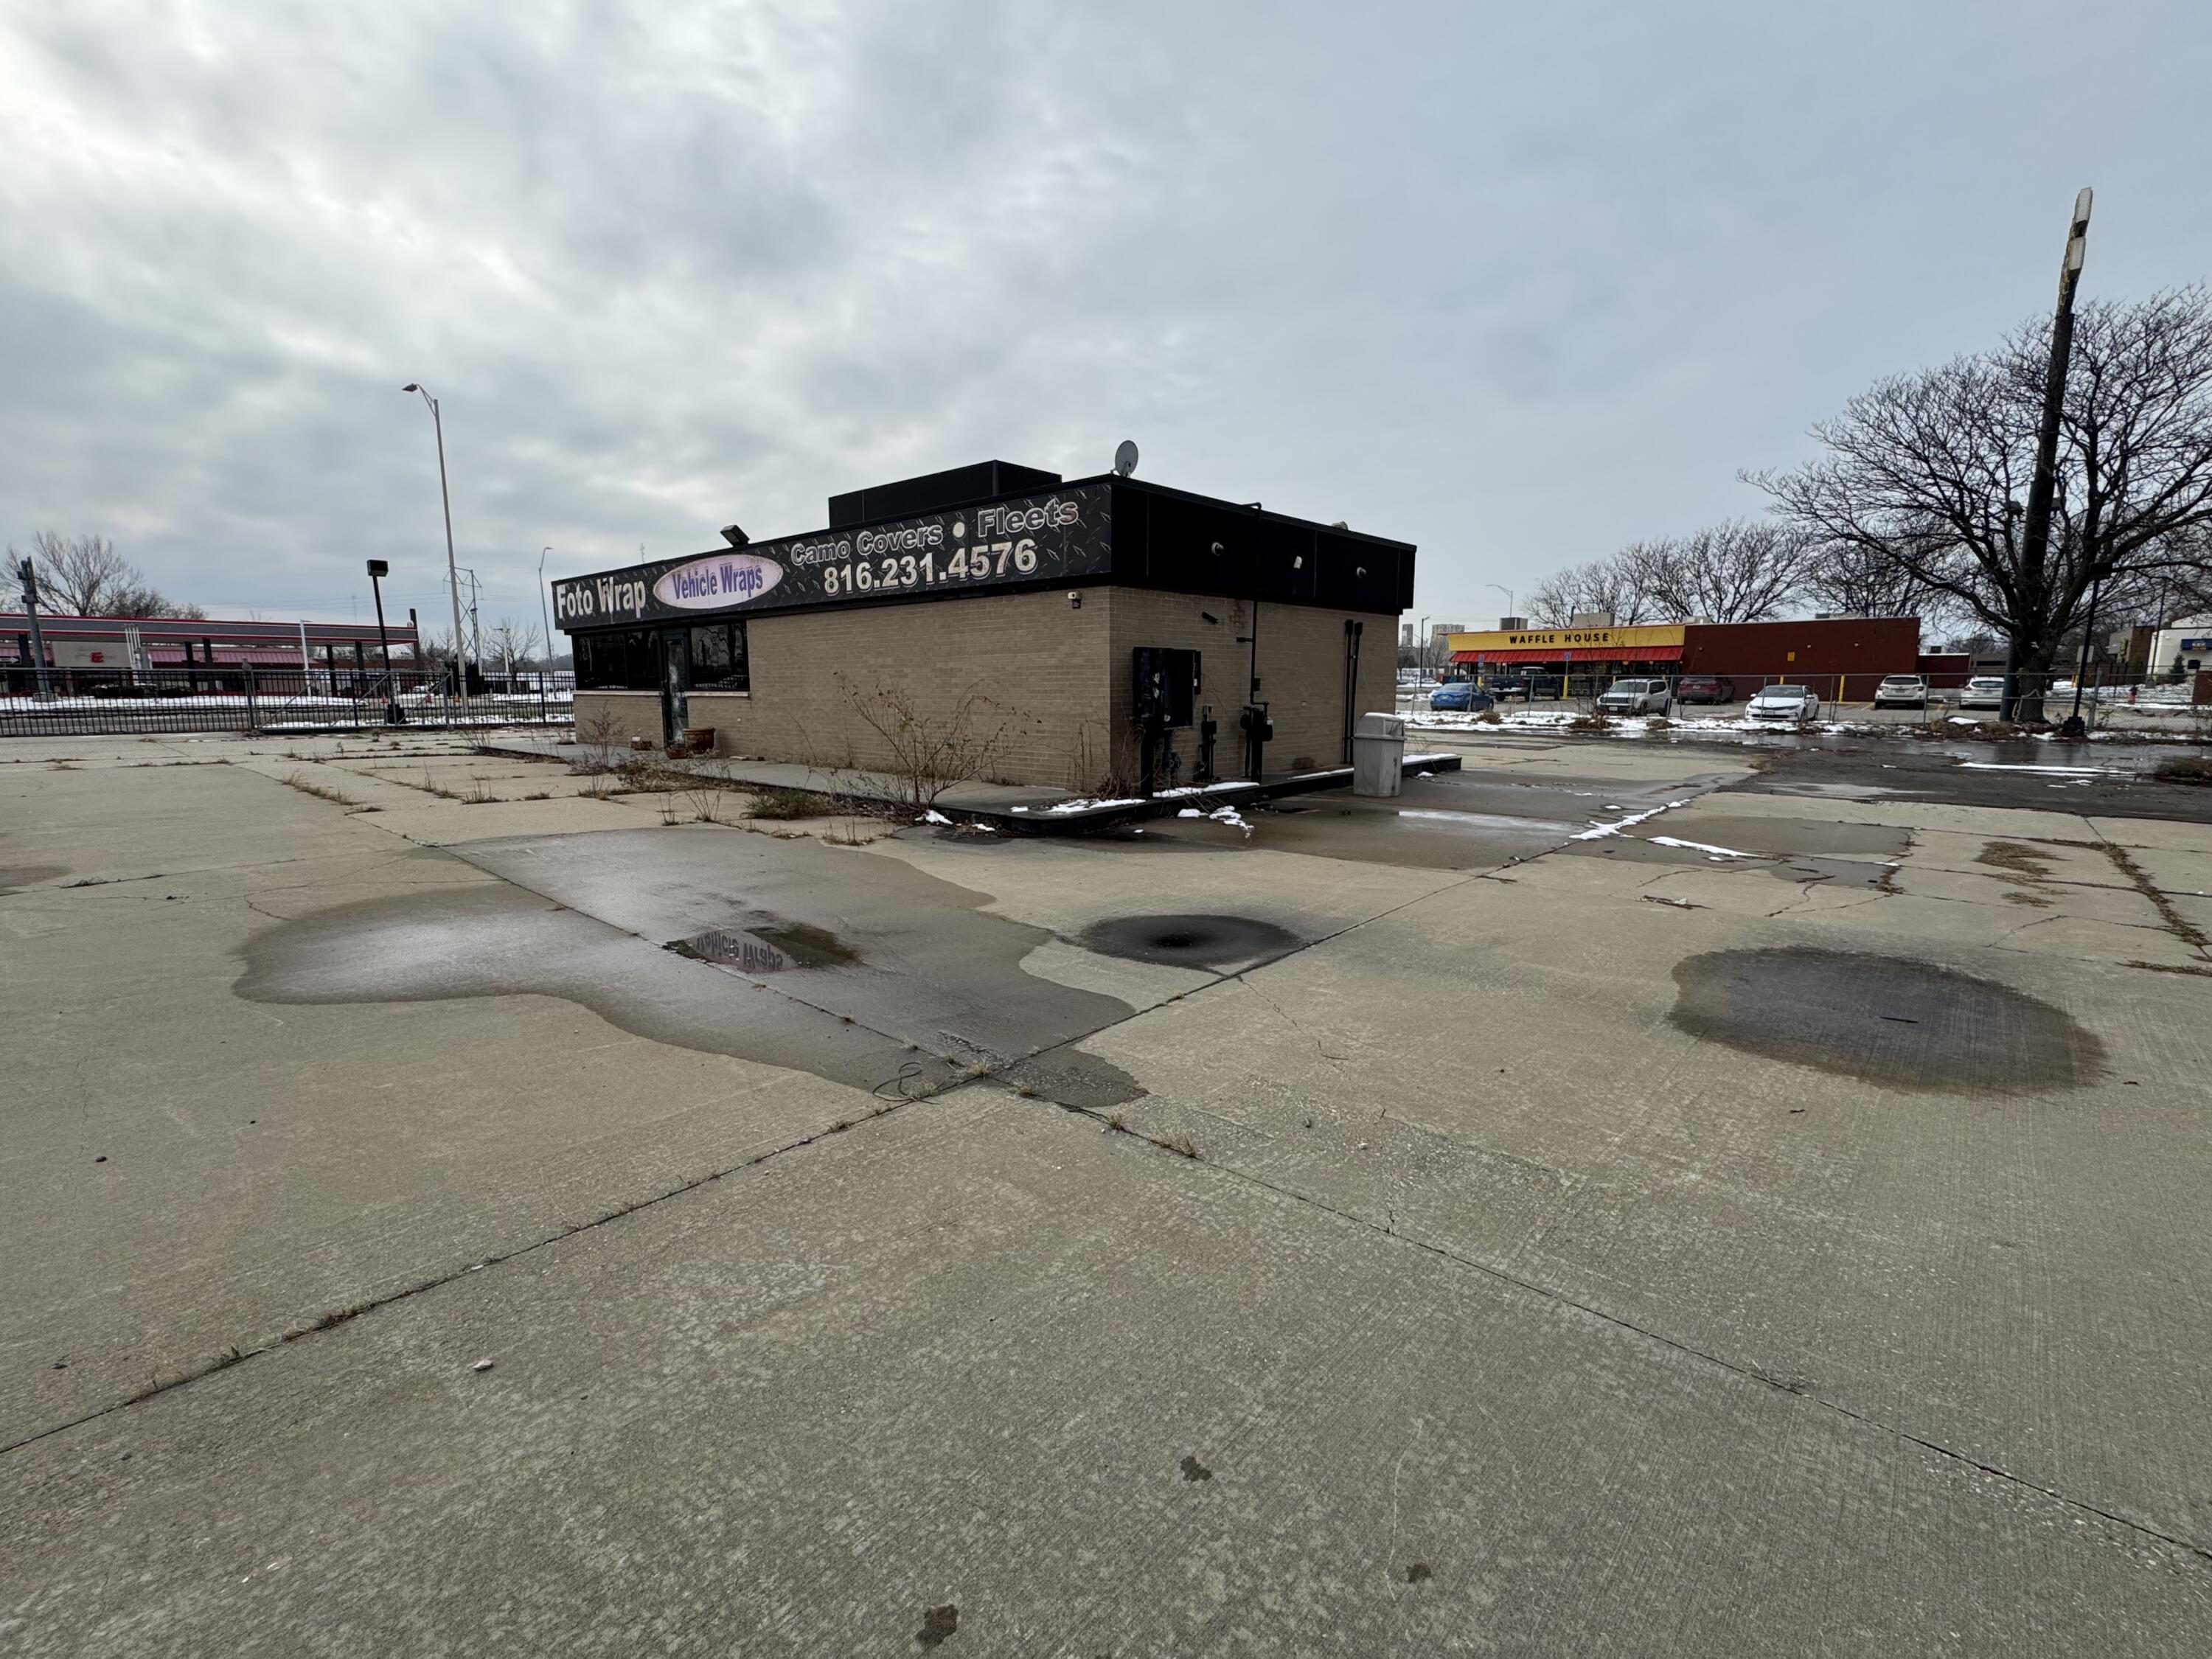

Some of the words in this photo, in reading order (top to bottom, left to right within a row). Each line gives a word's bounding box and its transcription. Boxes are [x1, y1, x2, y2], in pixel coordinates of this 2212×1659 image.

[791, 543, 851, 566] Camo
[857, 524, 943, 556] Covers
[978, 498, 1079, 538] Fleets
[672, 568, 717, 599] Vehicle
[720, 563, 763, 597] Wraps
[824, 538, 1037, 594] 816.231.4576
[556, 584, 594, 619] Foto
[597, 576, 646, 619] Wrap
[1509, 635, 1555, 644] WAFFLE
[1564, 633, 1610, 642] HOUSE
